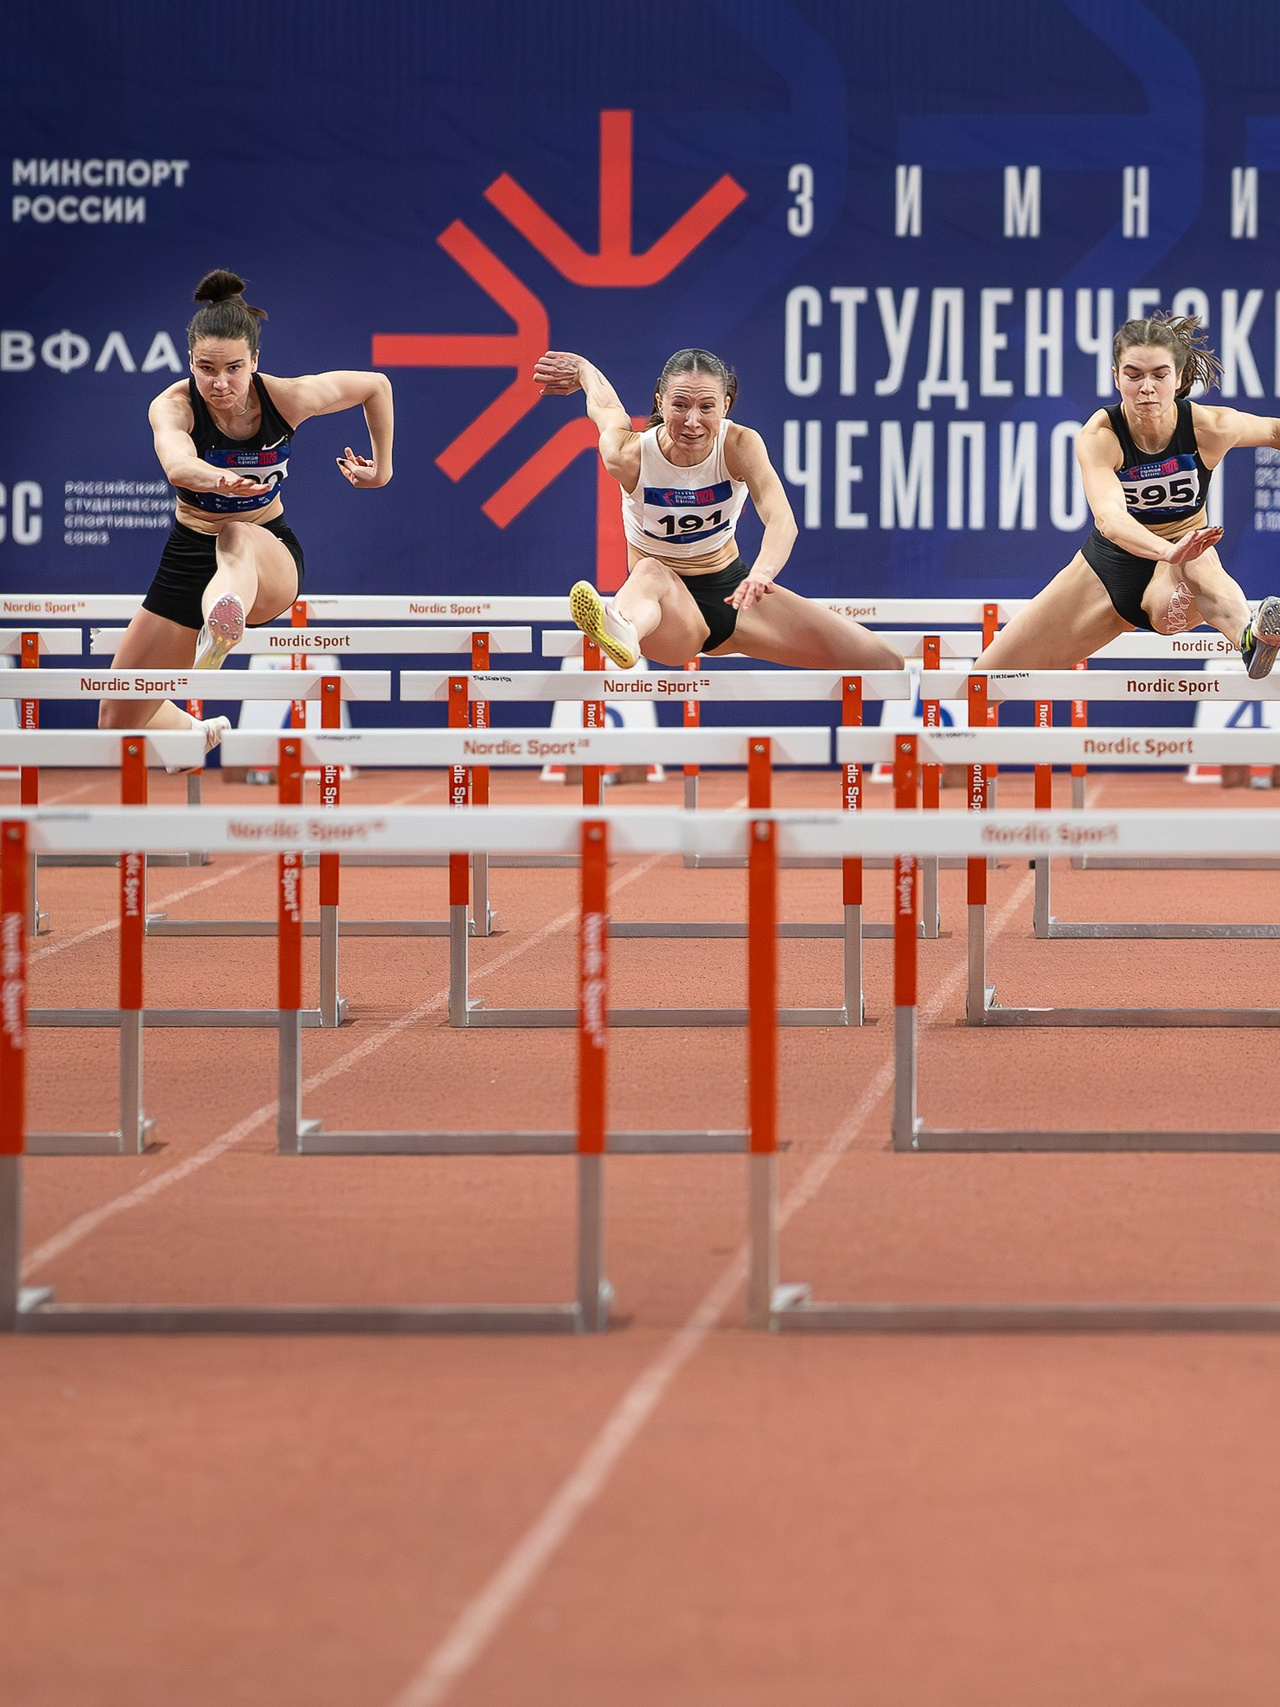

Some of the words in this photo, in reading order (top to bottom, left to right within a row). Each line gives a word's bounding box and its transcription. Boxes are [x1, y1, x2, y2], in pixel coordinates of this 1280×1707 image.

[12, 158, 190, 188] МИНСПОРТ
[12, 197, 146, 223] РОССИИ
[783, 420, 1225, 532] ЧЕМПИО
[657, 510, 722, 535] 191
[314, 634, 350, 650] Sport
[1216, 639, 1241, 654] Spo
[80, 678, 129, 692] Nordic
[134, 678, 176, 696] Sport
[603, 679, 653, 693] Nordic
[657, 680, 698, 696] Sport
[1178, 679, 1220, 698] Sport
[463, 741, 521, 754] Nordic
[527, 741, 576, 757] Sport
[1145, 739, 1194, 757] Sport
[972, 766, 985, 793] ordic
